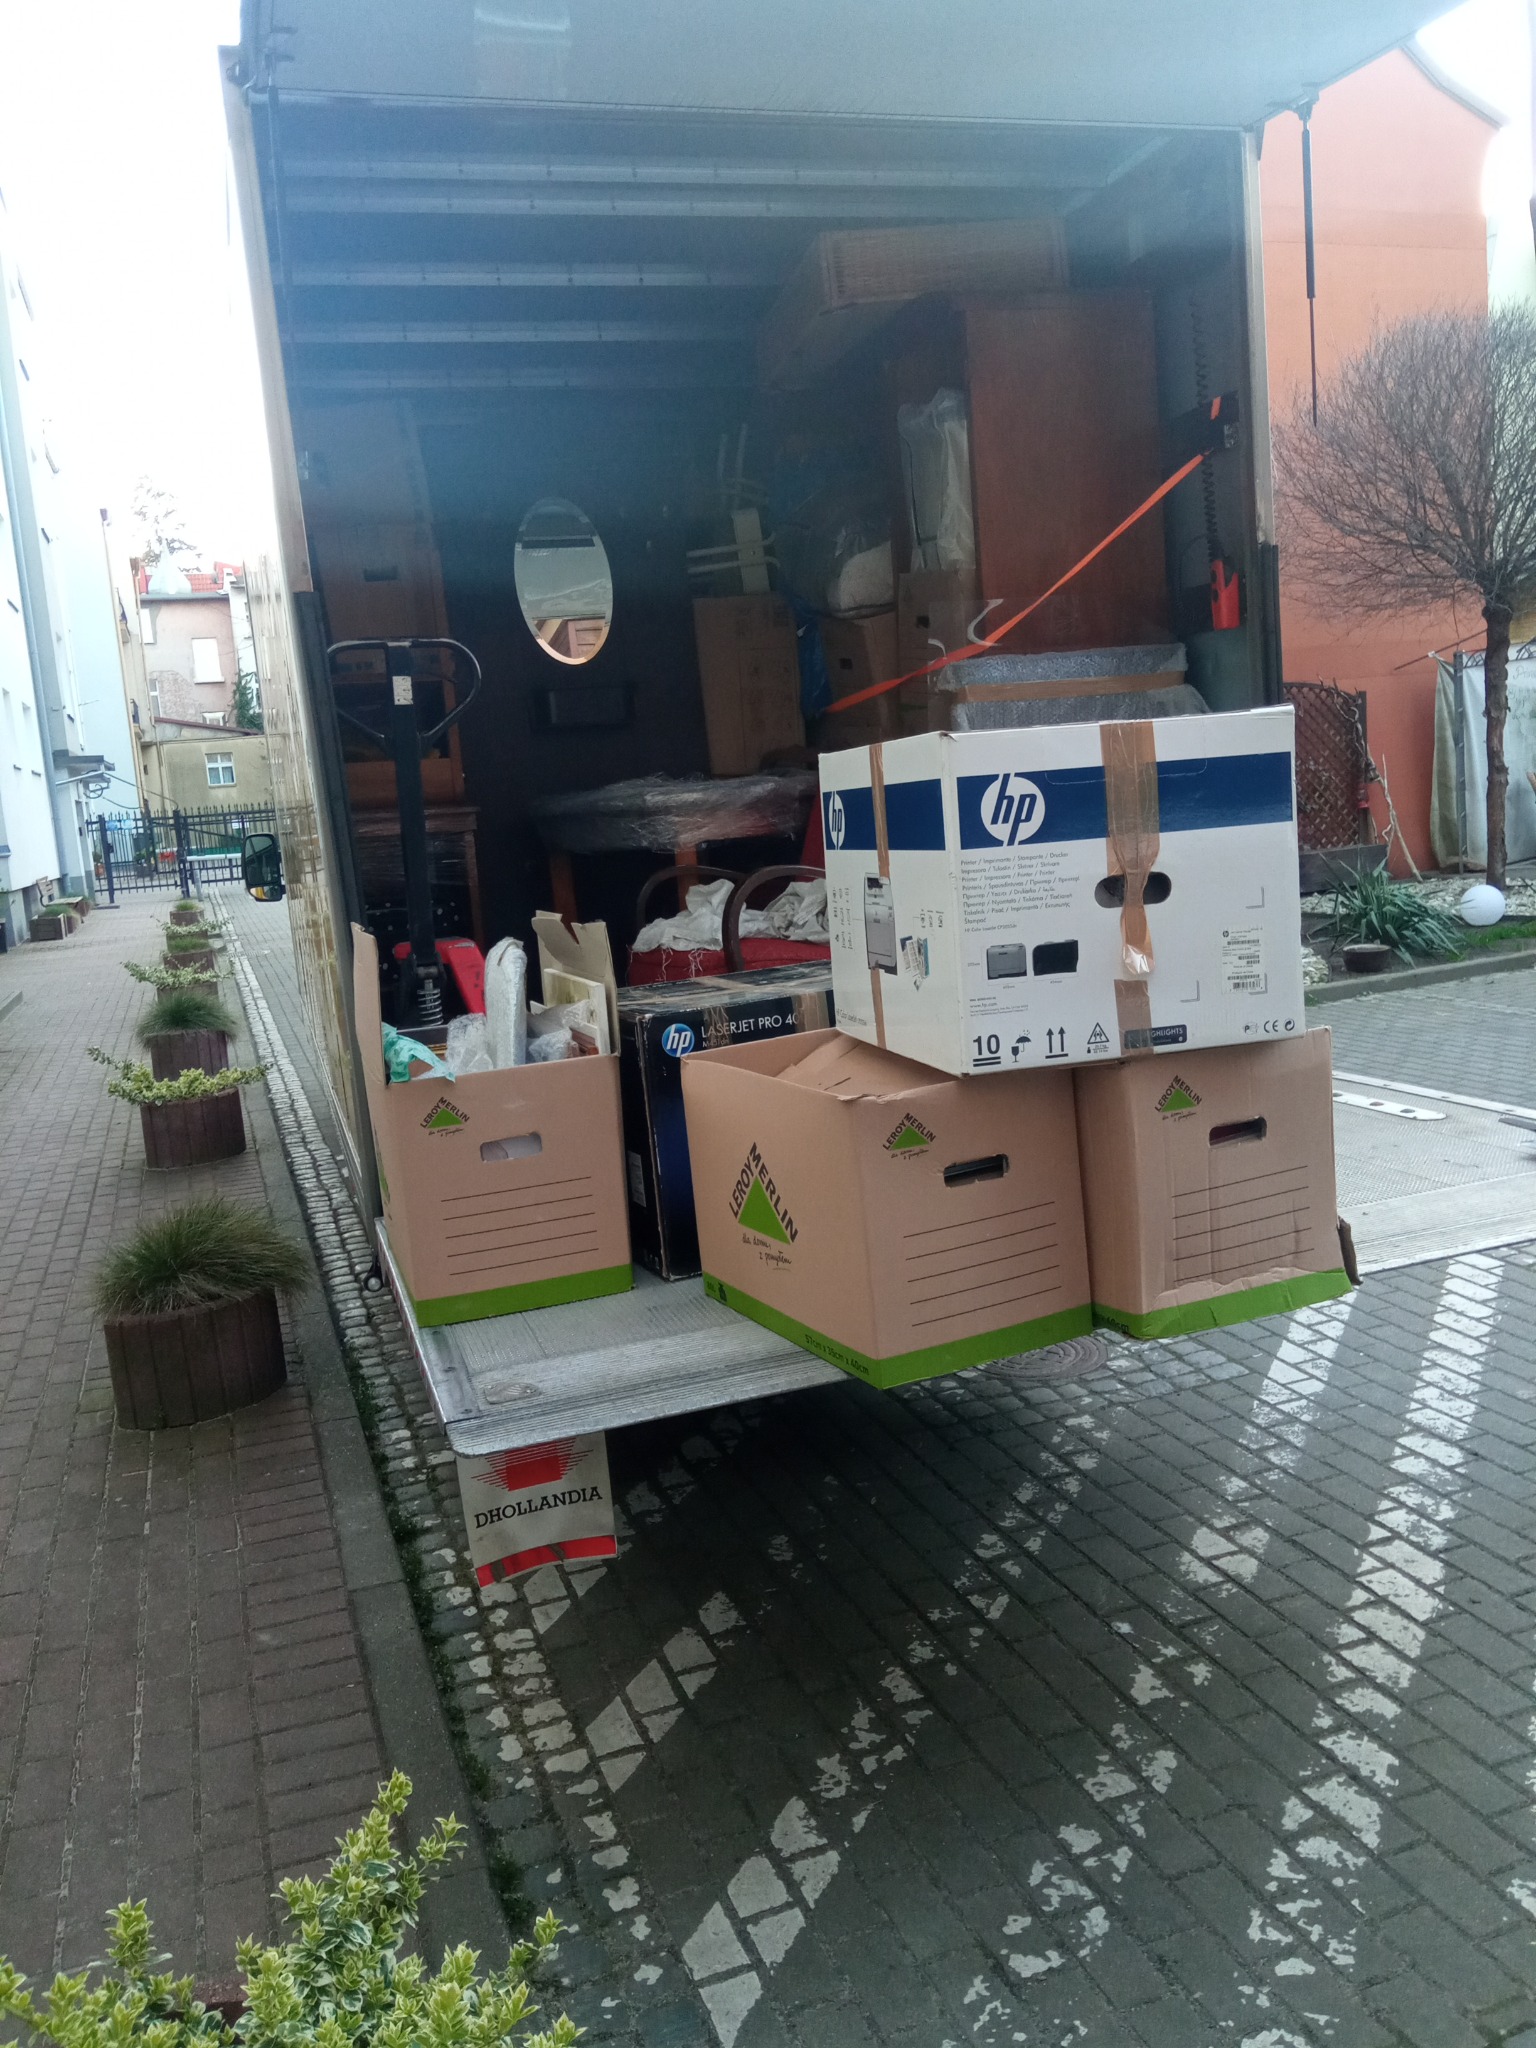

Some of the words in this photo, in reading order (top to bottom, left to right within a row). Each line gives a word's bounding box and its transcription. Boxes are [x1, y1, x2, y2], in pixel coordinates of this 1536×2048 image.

[832, 791, 842, 850] hp
[990, 773, 1037, 847] hp
[666, 1023, 692, 1057] hp
[701, 1018, 755, 1038] LASERJET
[758, 1015, 782, 1030] PRO
[973, 1034, 1000, 1056] 10
[420, 1102, 442, 1129] LEROY
[439, 1096, 470, 1123] MERLIN
[1154, 1081, 1176, 1113] LEROY
[1173, 1074, 1202, 1105] MERLIN
[882, 1119, 907, 1150] LEROY
[903, 1112, 936, 1143] MERLIN
[729, 1156, 754, 1219] LEROY
[749, 1141, 798, 1243] MERLIN
[473, 1486, 603, 1529] DHOLLANDIA
